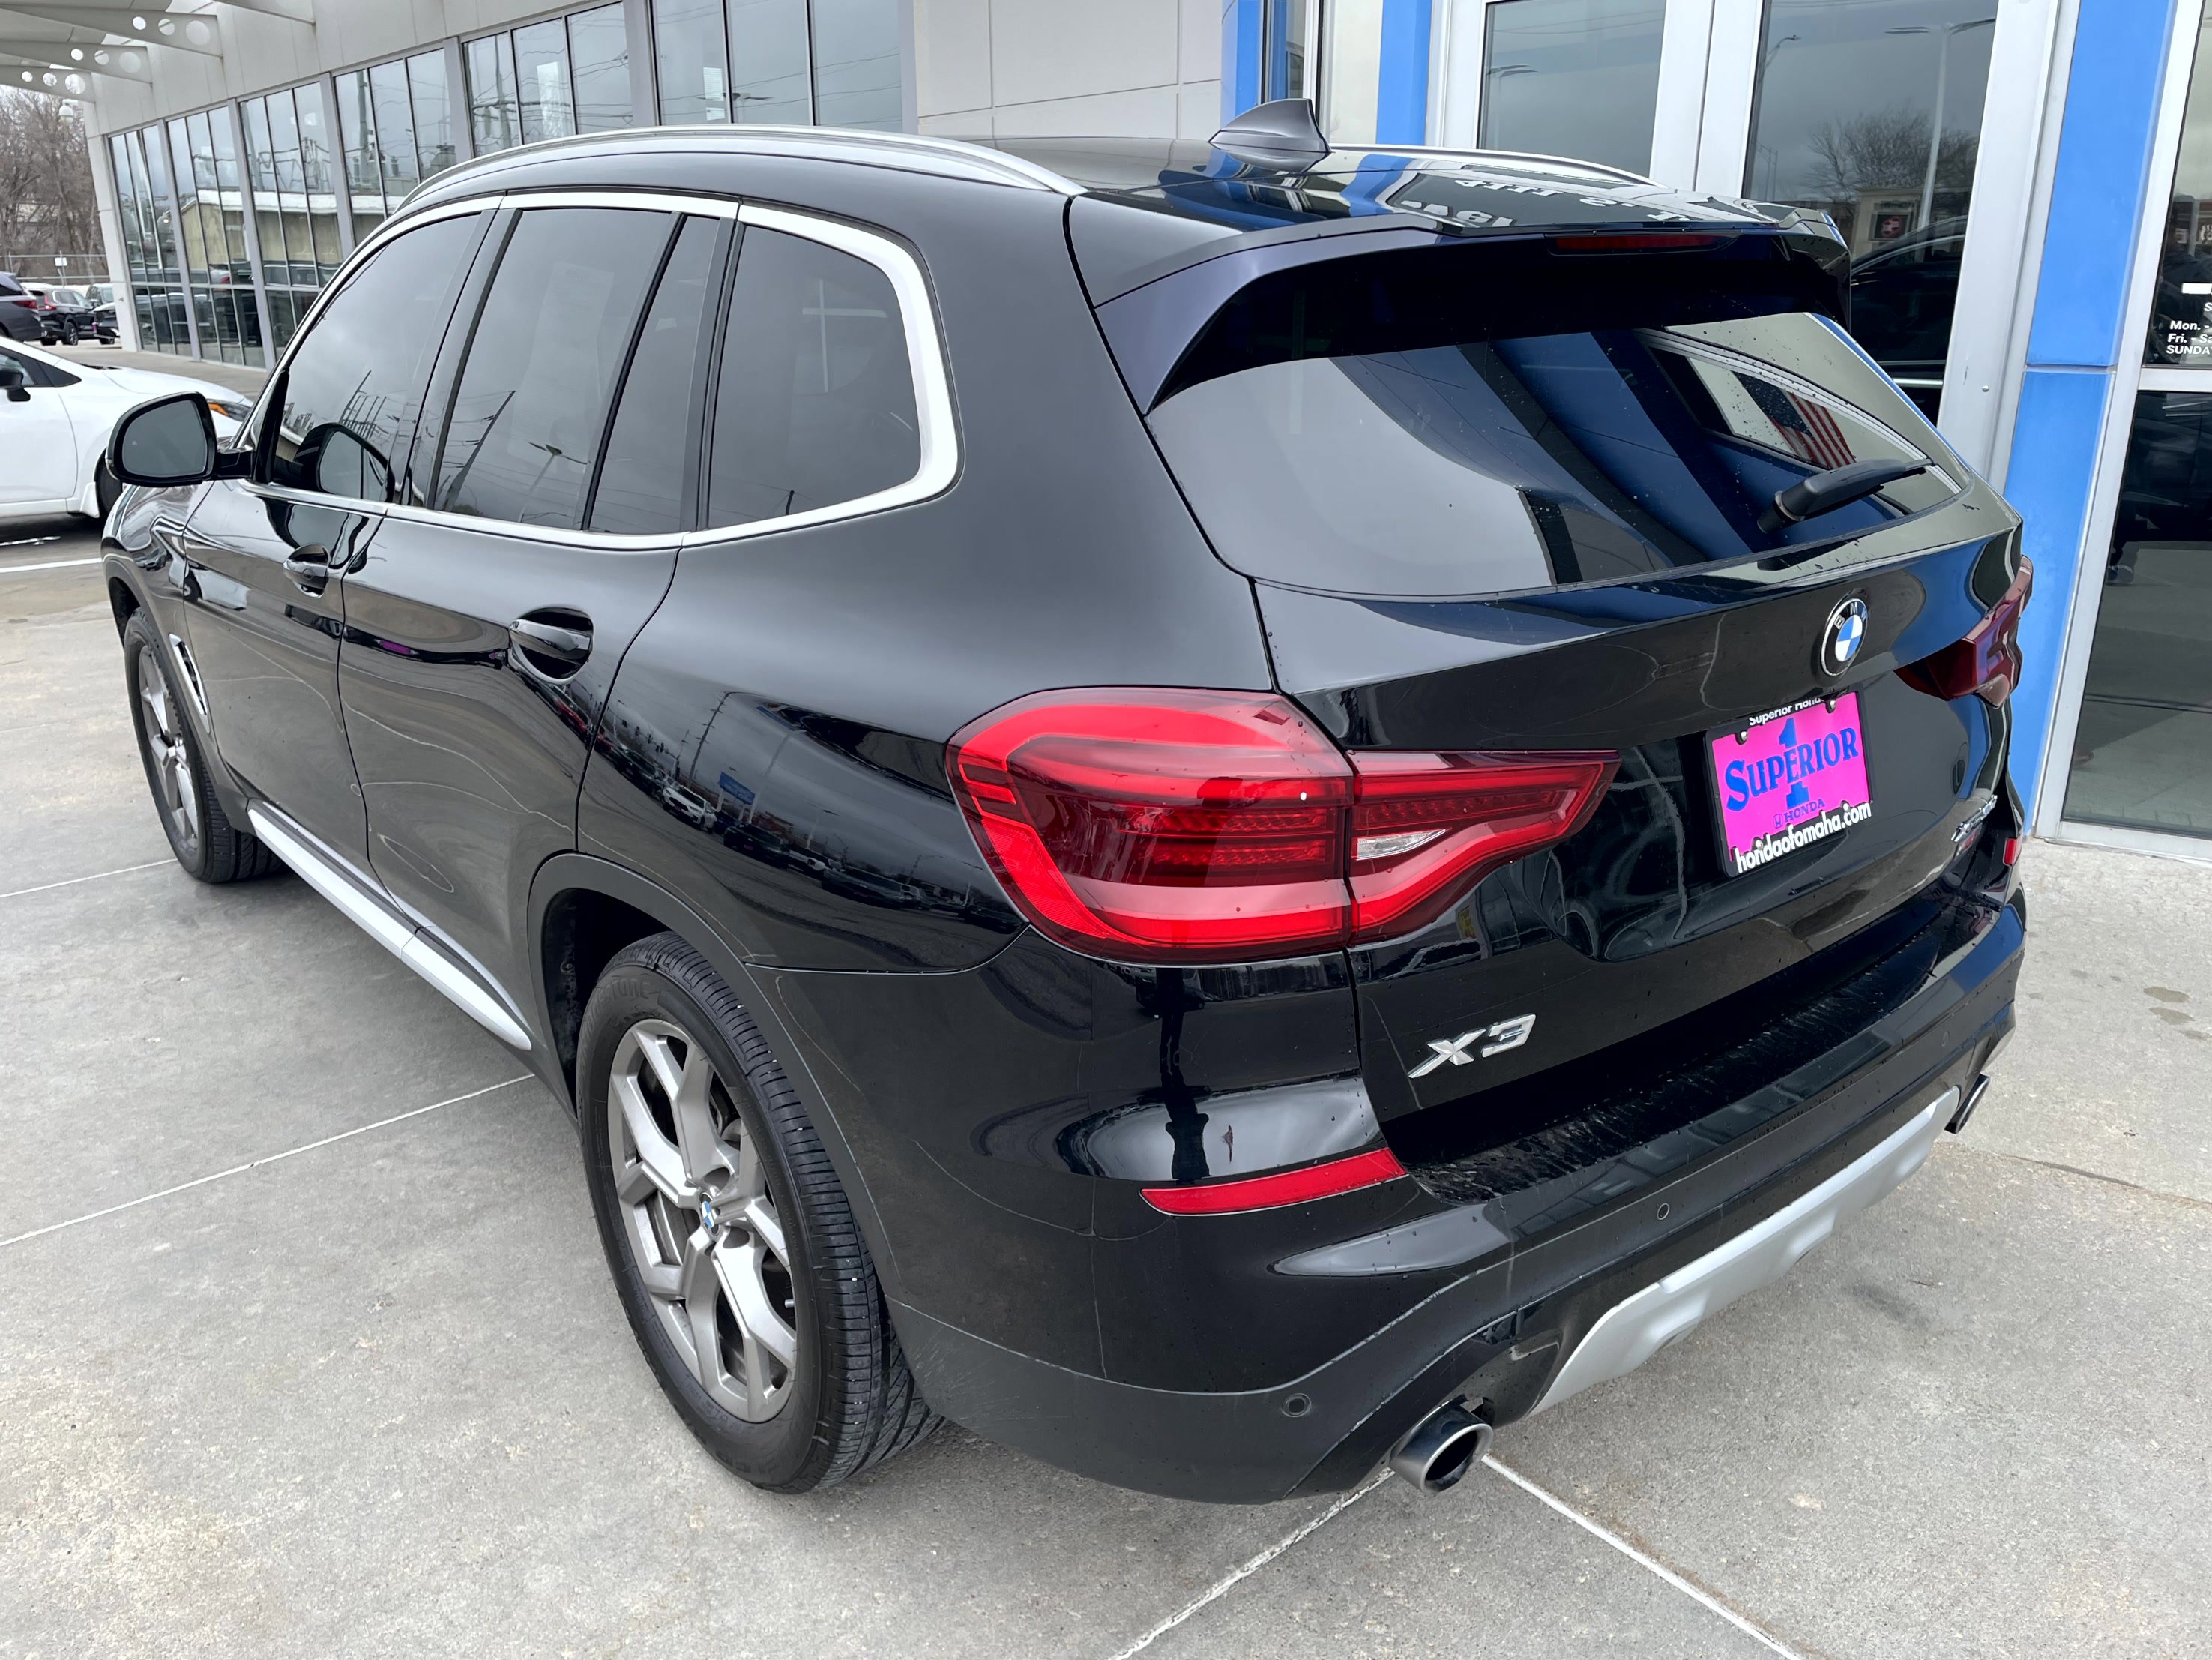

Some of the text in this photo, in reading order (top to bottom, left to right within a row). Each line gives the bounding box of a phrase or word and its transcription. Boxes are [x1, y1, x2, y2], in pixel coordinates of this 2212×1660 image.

[2169, 320, 2201, 330] Mon.
[2167, 333, 2187, 343] Fri.
[2166, 345, 2212, 355] SUNDA
[1749, 705, 1793, 726] Superior
[1725, 727, 1860, 812] SUPERIOR
[1784, 799, 1826, 822] HONDA
[1734, 801, 1872, 873] hondaofomaha.com
[1408, 1014, 1537, 1079] X3
